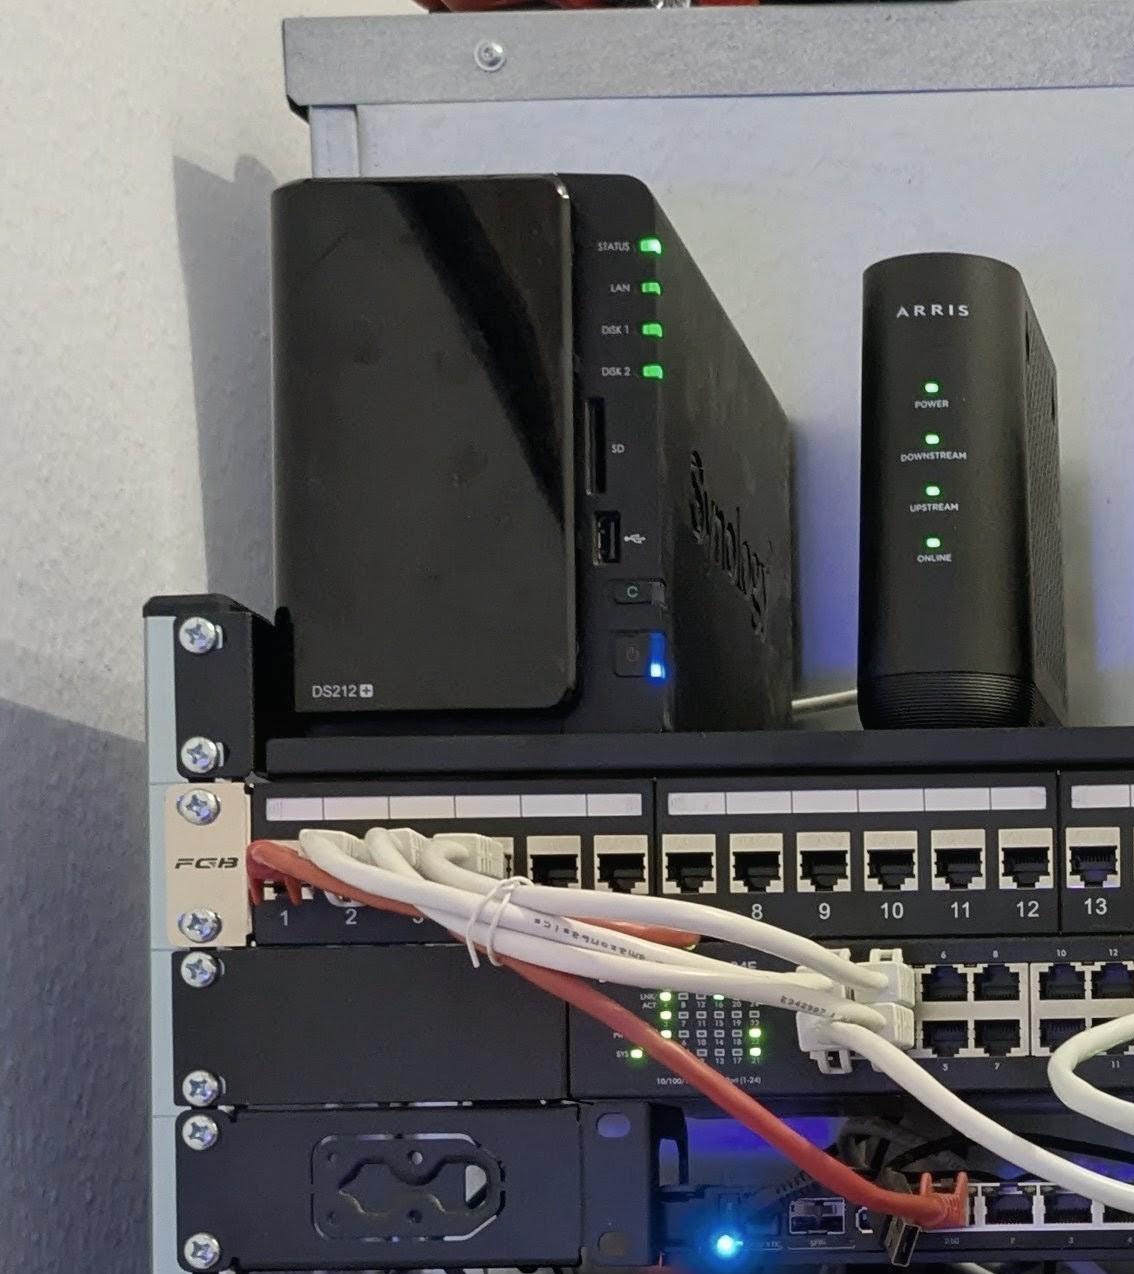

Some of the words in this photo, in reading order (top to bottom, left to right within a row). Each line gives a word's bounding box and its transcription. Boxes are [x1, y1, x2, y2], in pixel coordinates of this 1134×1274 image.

[598, 241, 630, 252] STATUS
[610, 283, 631, 293] LAN
[896, 304, 970, 318] ARRIS
[601, 325, 622, 335] DISK
[601, 366, 622, 377] DISK
[624, 366, 631, 377] 2
[914, 400, 949, 408] POWER
[611, 443, 625, 454] SD
[900, 451, 967, 463] DOWNSTREAM
[910, 503, 959, 513] UPSTREAM
[917, 553, 952, 563] ONLINE
[751, 904, 763, 920] 8
[818, 903, 831, 919] 9
[880, 902, 904, 918] 10
[951, 902, 970, 918] 11
[1016, 901, 1039, 917] 12
[1084, 898, 1107, 915] 13
[280, 909, 289, 926] 1
[345, 908, 358, 925] 2
[940, 950, 947, 959] 6
[1056, 948, 1067, 957] 10
[1109, 948, 1118, 957] 12
[994, 1062, 1000, 1071] 7
[1111, 1060, 1120, 1069] 11
